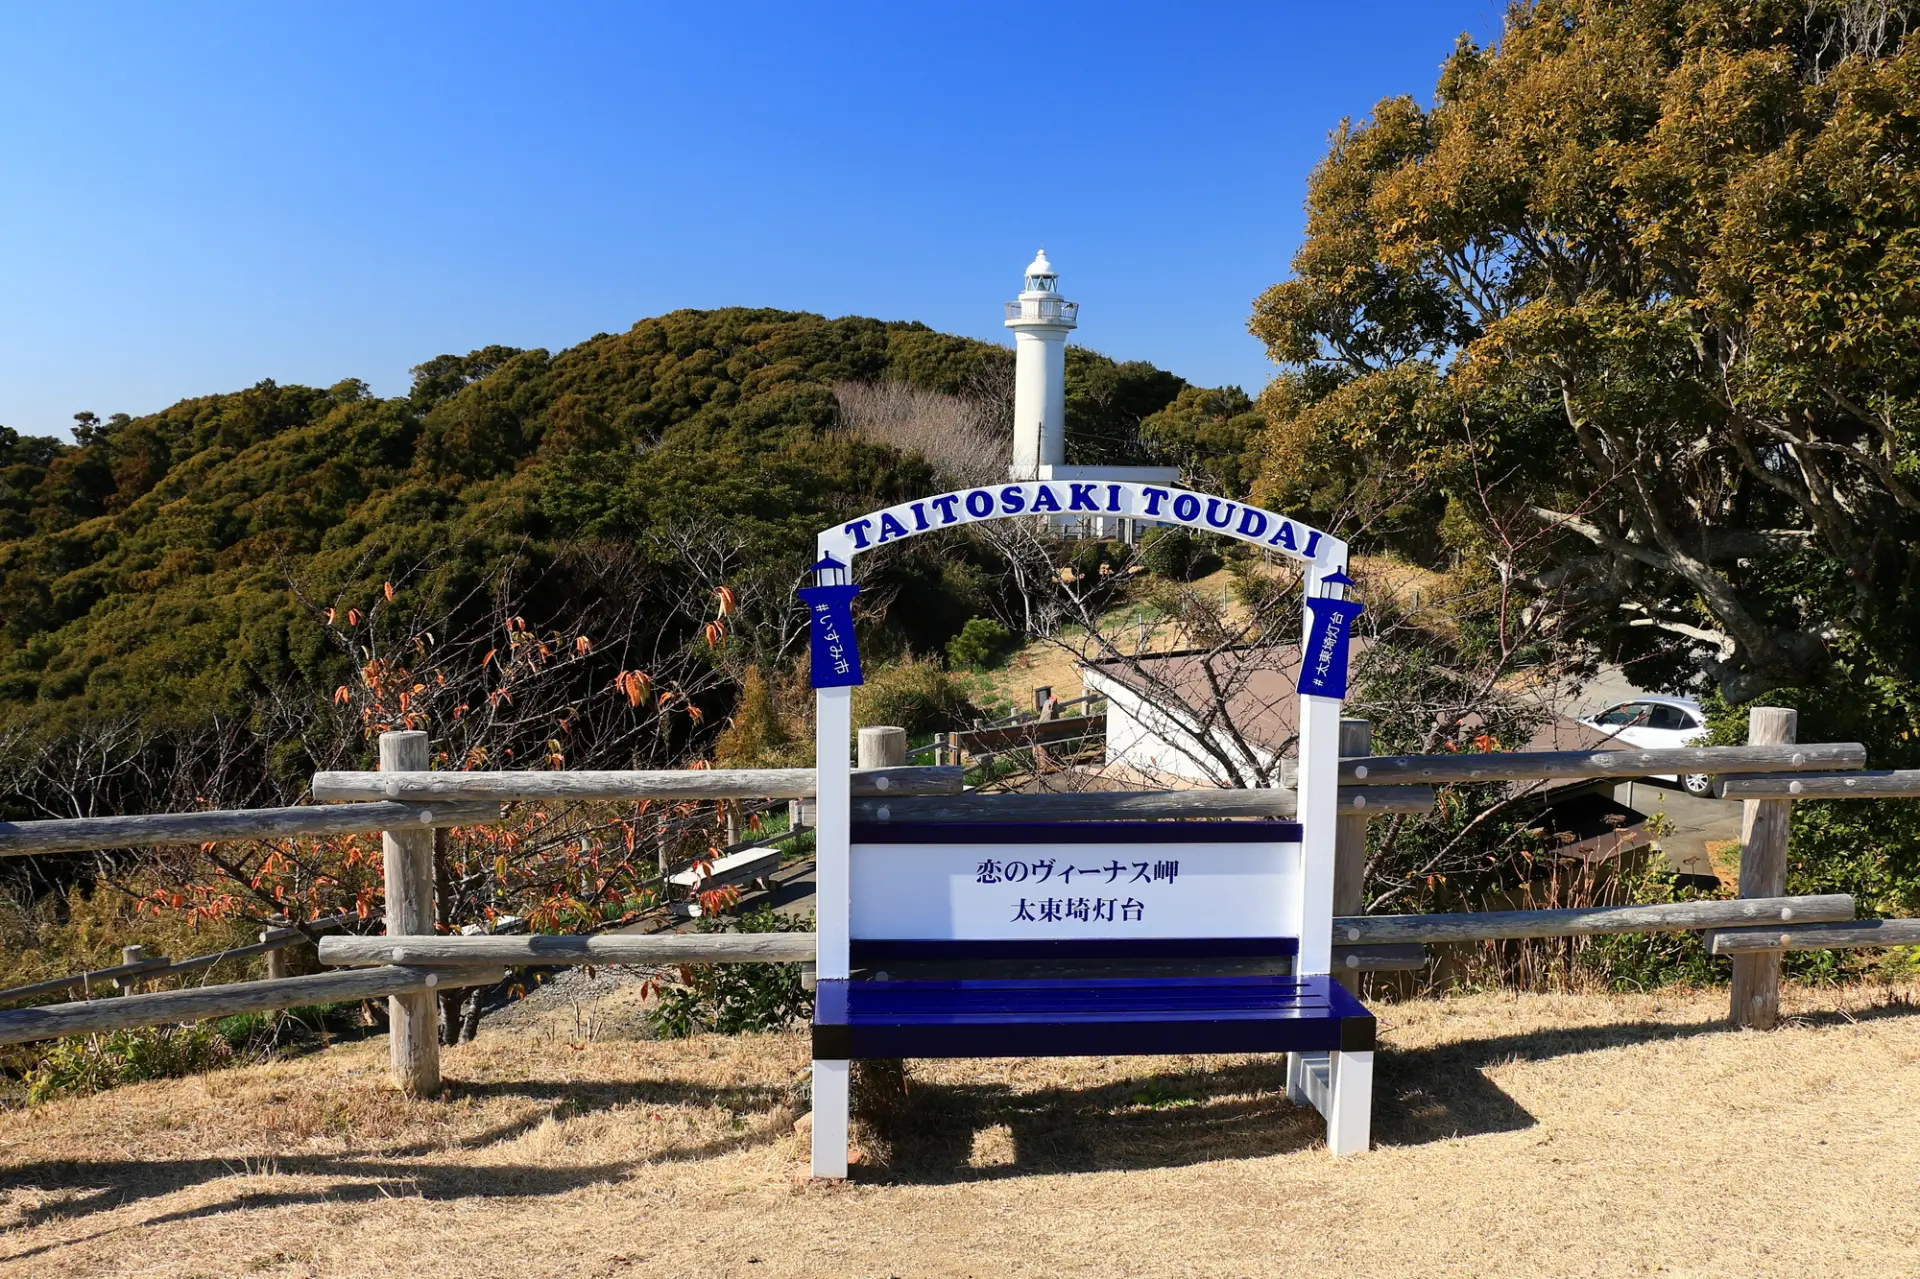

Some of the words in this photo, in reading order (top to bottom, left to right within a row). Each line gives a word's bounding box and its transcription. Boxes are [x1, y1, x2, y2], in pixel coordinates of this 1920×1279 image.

[844, 483, 1122, 549] TAITOSAKI
[1142, 486, 1323, 558] TOUDAI
[815, 603, 850, 675] #いすみ市
[976, 858, 1180, 885] 恋のヴィーナス岬
[1010, 897, 1145, 923] 太東埼灯台
